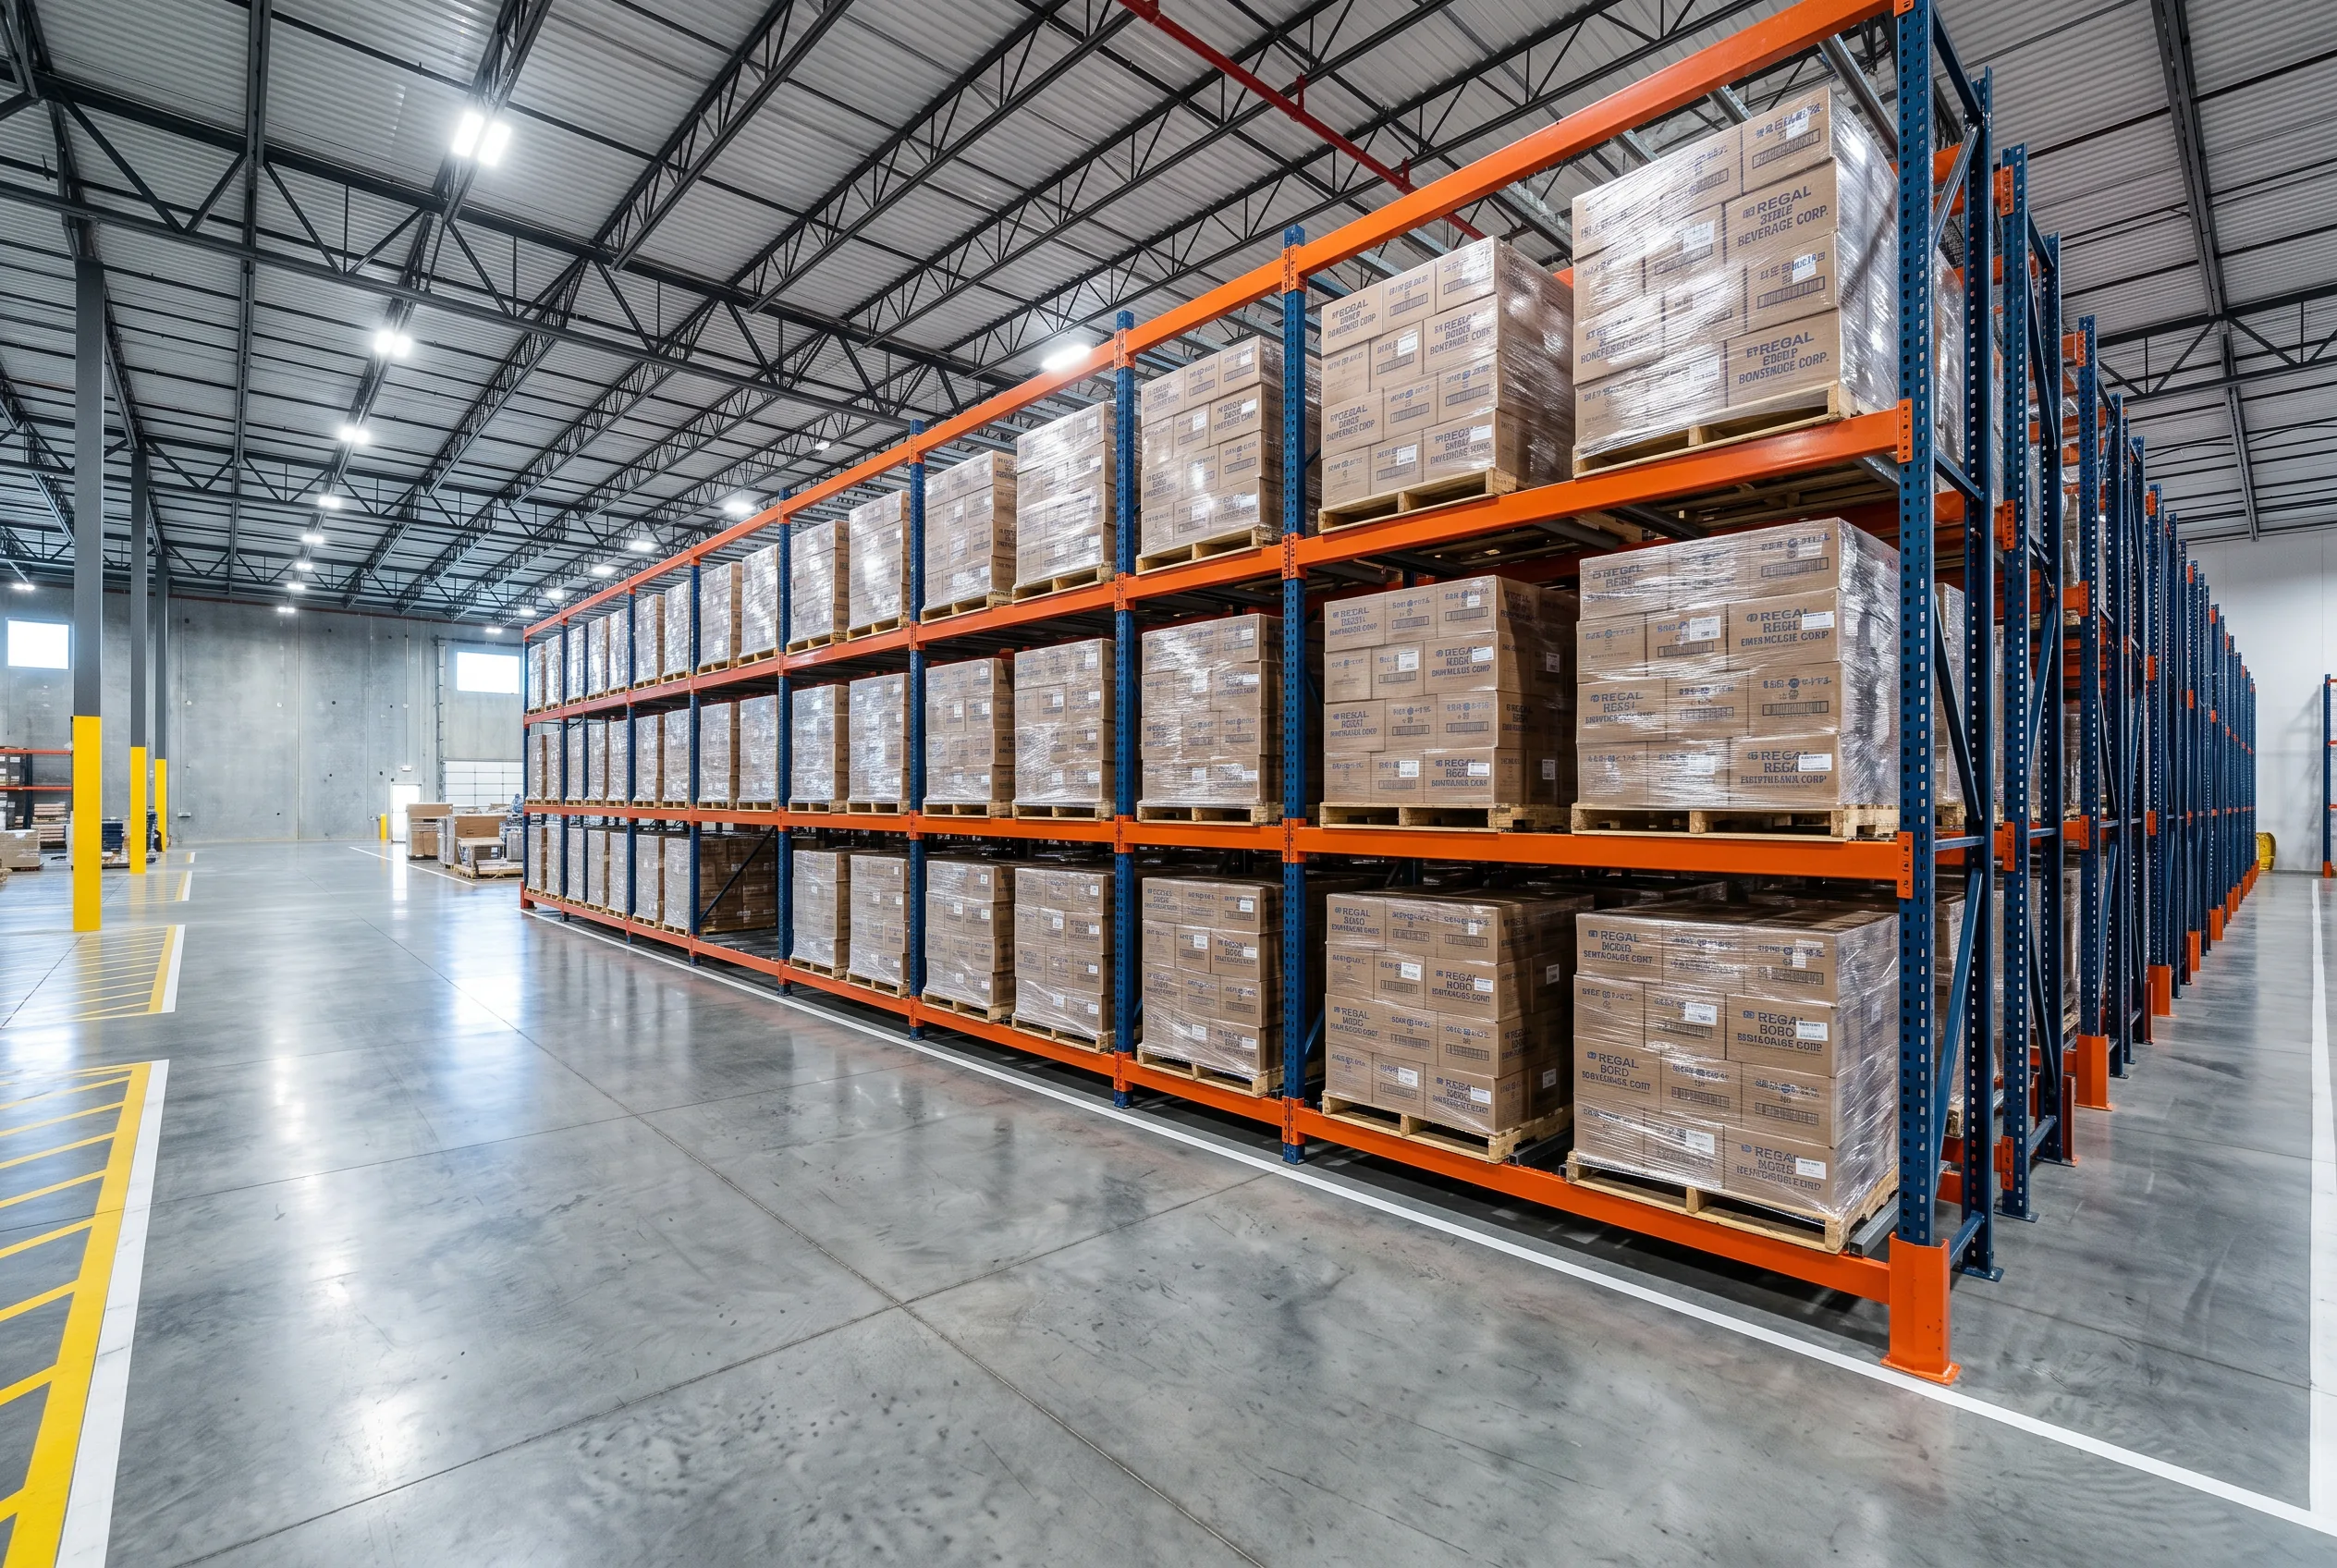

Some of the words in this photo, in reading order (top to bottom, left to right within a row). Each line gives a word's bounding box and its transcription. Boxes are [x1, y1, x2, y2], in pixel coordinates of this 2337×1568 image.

[1756, 186, 1812, 214] REGAL
[1738, 216, 1793, 248] BEVERAGE
[1796, 204, 1829, 226] CORP.
[1444, 758, 1476, 767] REGA
[1760, 751, 1809, 761] REGA
[1343, 907, 1372, 918] REGAL
[1600, 930, 1641, 943] REGAL
[1757, 1011, 1805, 1025] REGA
[1598, 1052, 1640, 1070] REGAL
[1600, 1064, 1630, 1077] BORD
